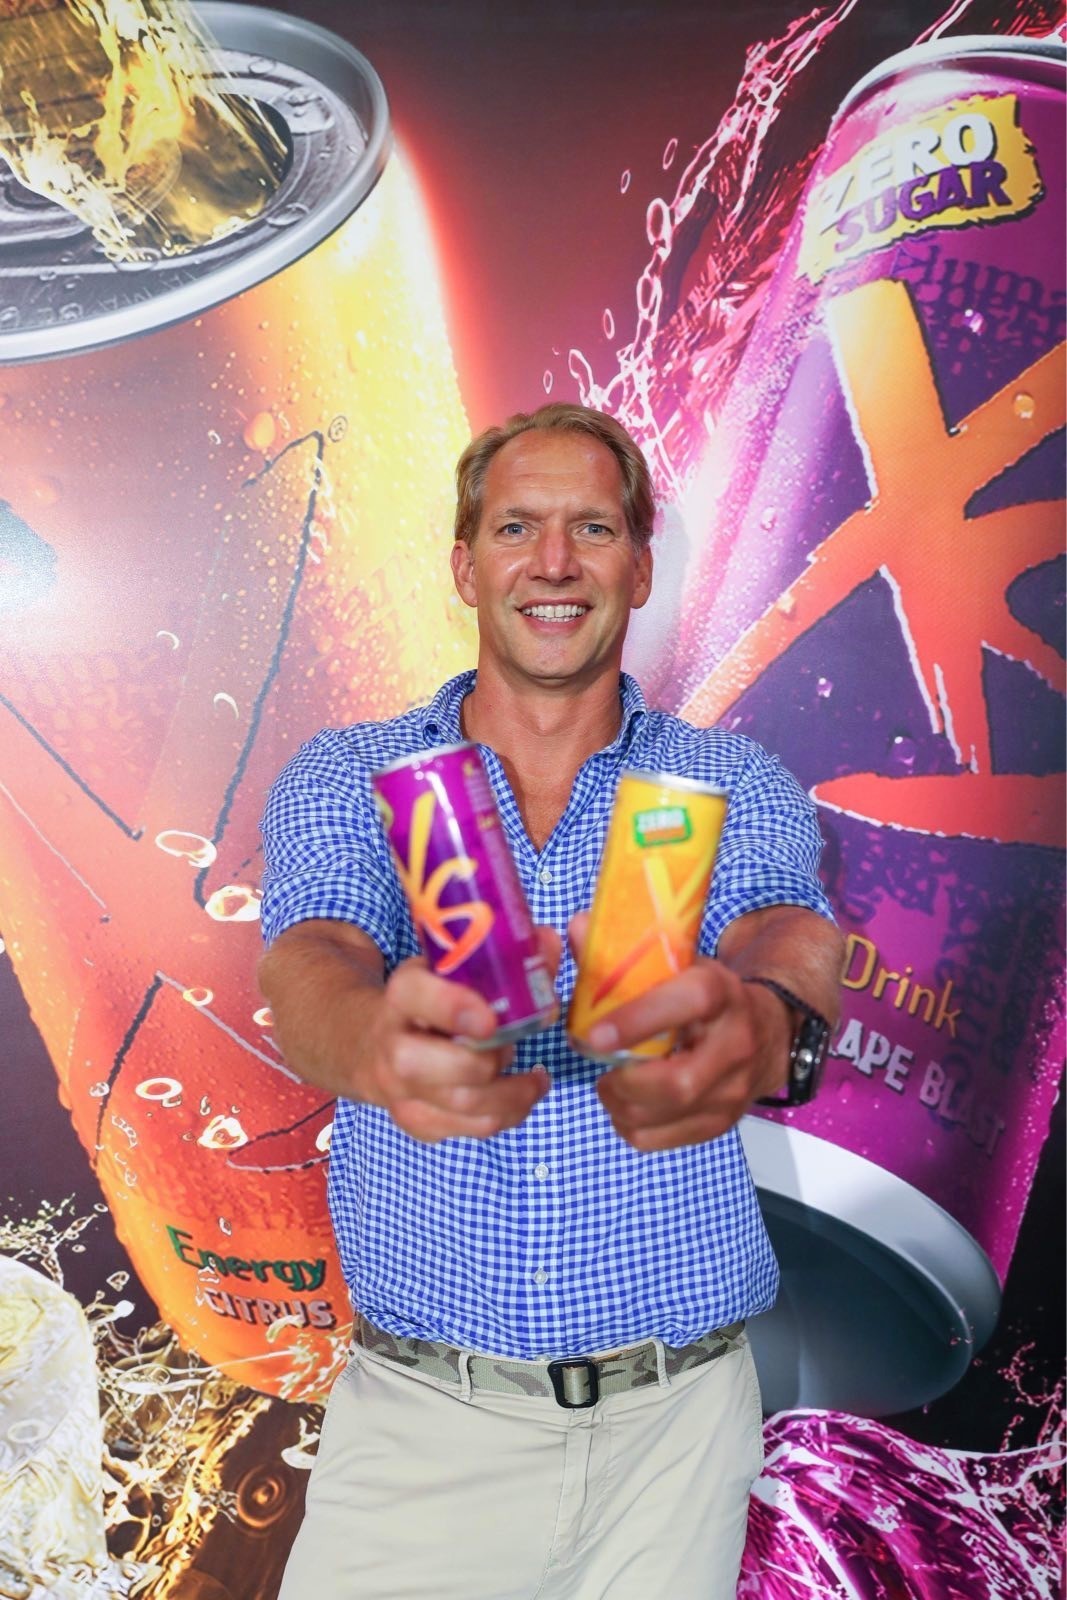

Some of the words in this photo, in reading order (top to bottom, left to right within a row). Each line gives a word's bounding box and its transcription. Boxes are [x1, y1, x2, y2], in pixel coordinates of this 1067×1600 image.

[819, 113, 997, 236] ZERO
[833, 160, 1013, 253] SUGAR
[841, 933, 962, 1038] Drink
[829, 1018, 915, 1094] APE
[166, 1224, 327, 1293] Energy
[203, 1286, 337, 1331] CITRUS
